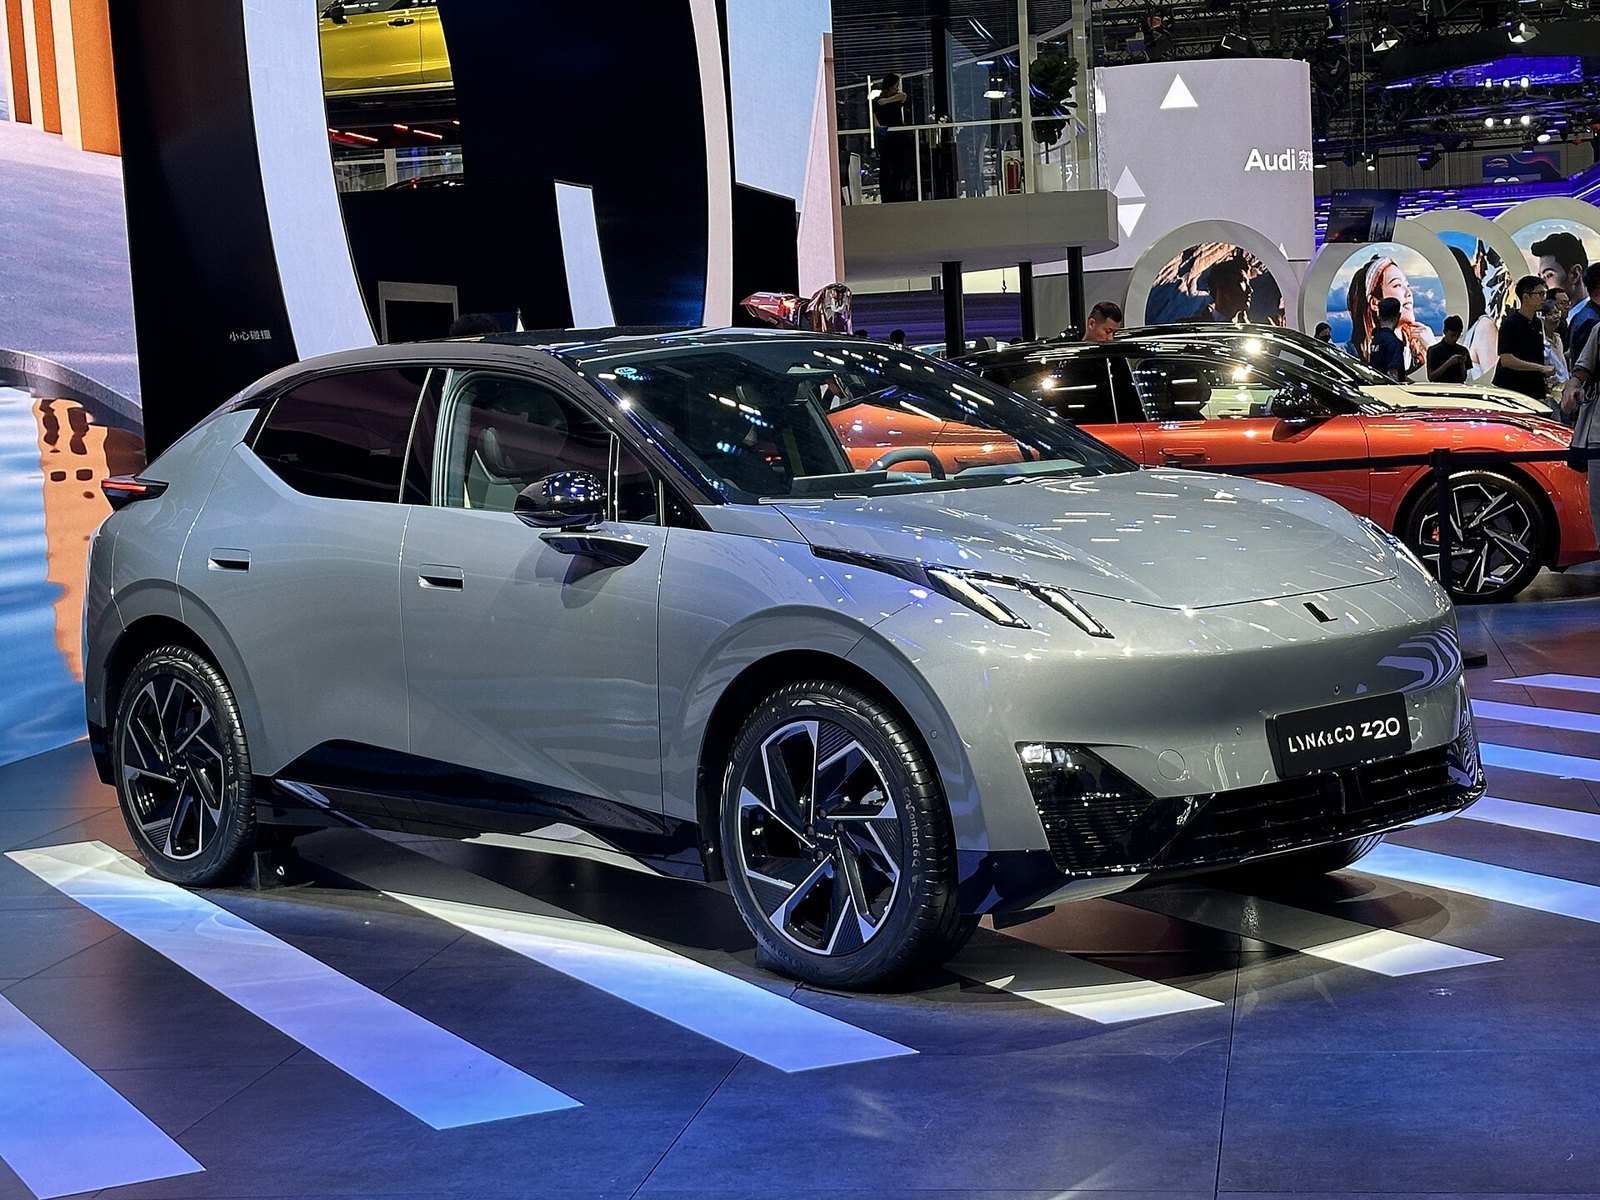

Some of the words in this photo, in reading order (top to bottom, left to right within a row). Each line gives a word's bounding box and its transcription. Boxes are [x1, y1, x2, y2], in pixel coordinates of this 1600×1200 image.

[1243, 148, 1296, 171] Audi
[229, 329, 272, 341] 小心碰撞
[1360, 717, 1400, 740] Z20
